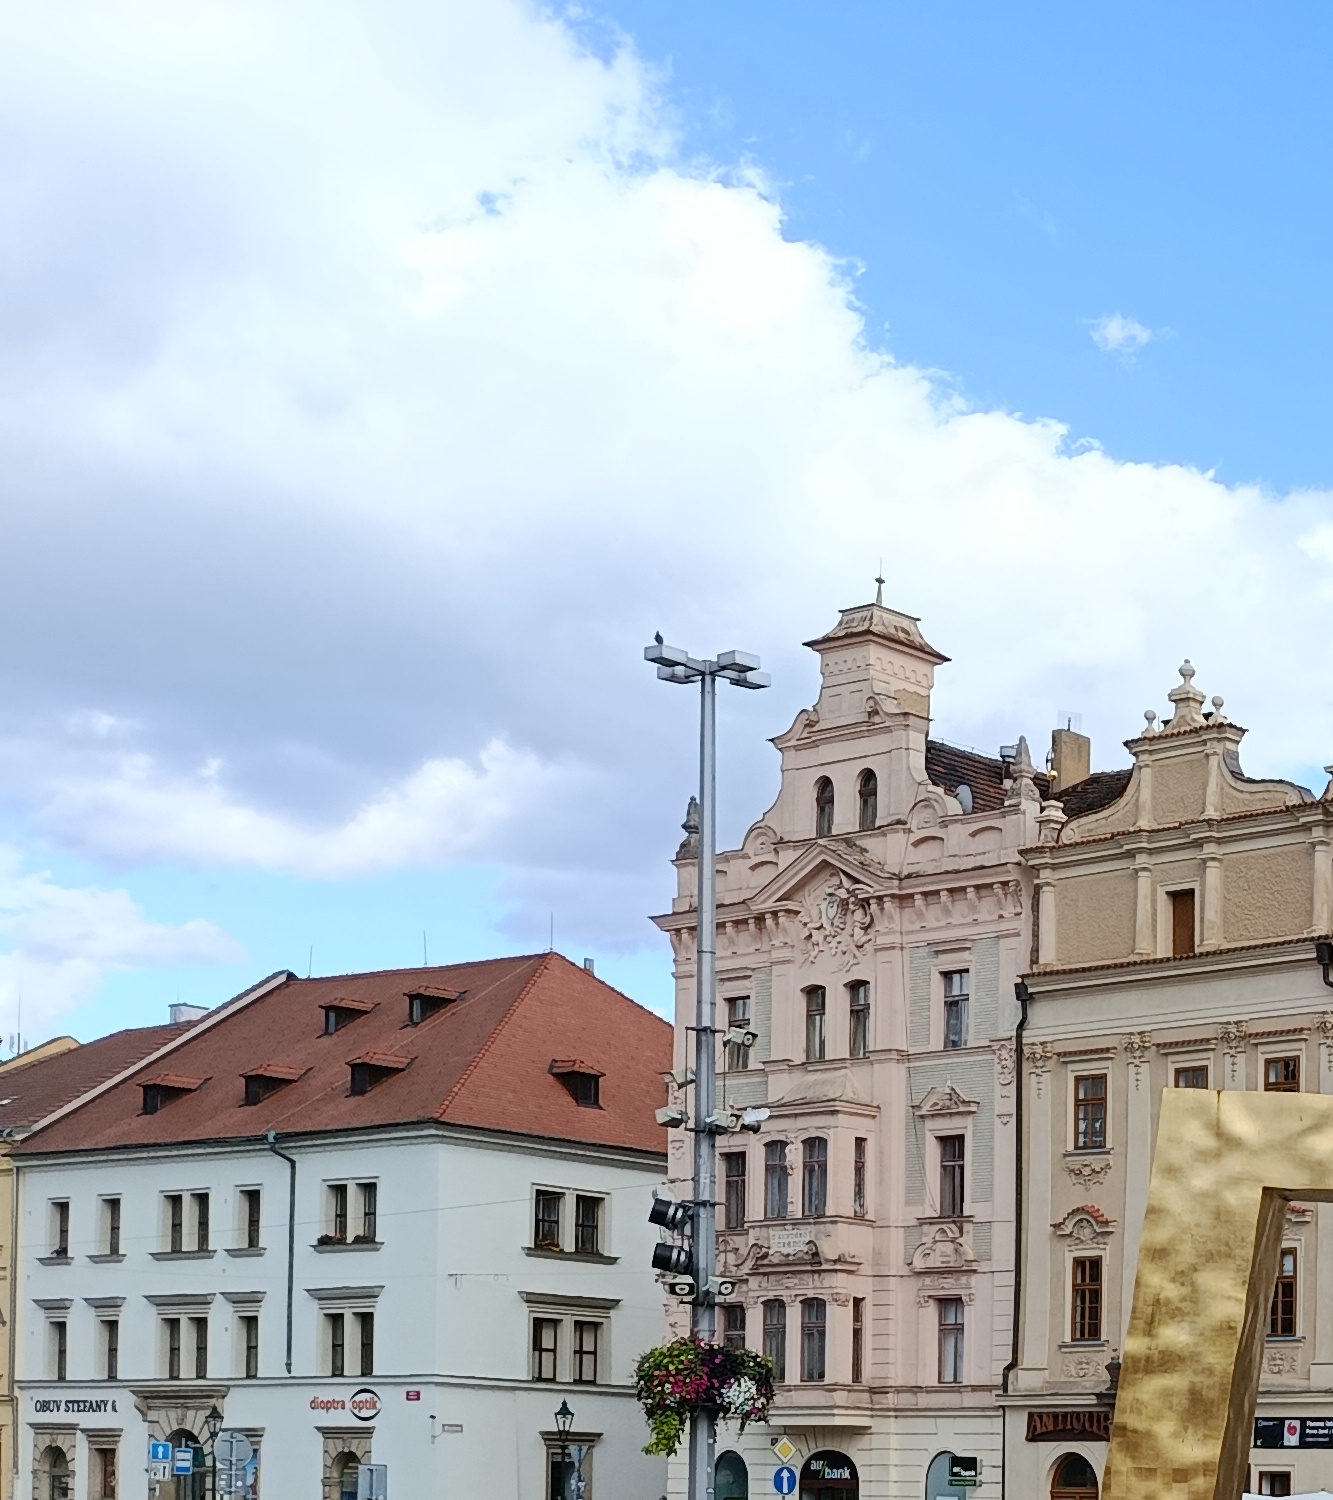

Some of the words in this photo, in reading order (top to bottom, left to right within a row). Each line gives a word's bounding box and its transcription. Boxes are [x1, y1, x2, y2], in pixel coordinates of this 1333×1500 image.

[34, 1399, 62, 1413] OBUV
[309, 1395, 346, 1414] dioptra
[351, 1396, 378, 1413] optik
[824, 1466, 851, 1480] bank
